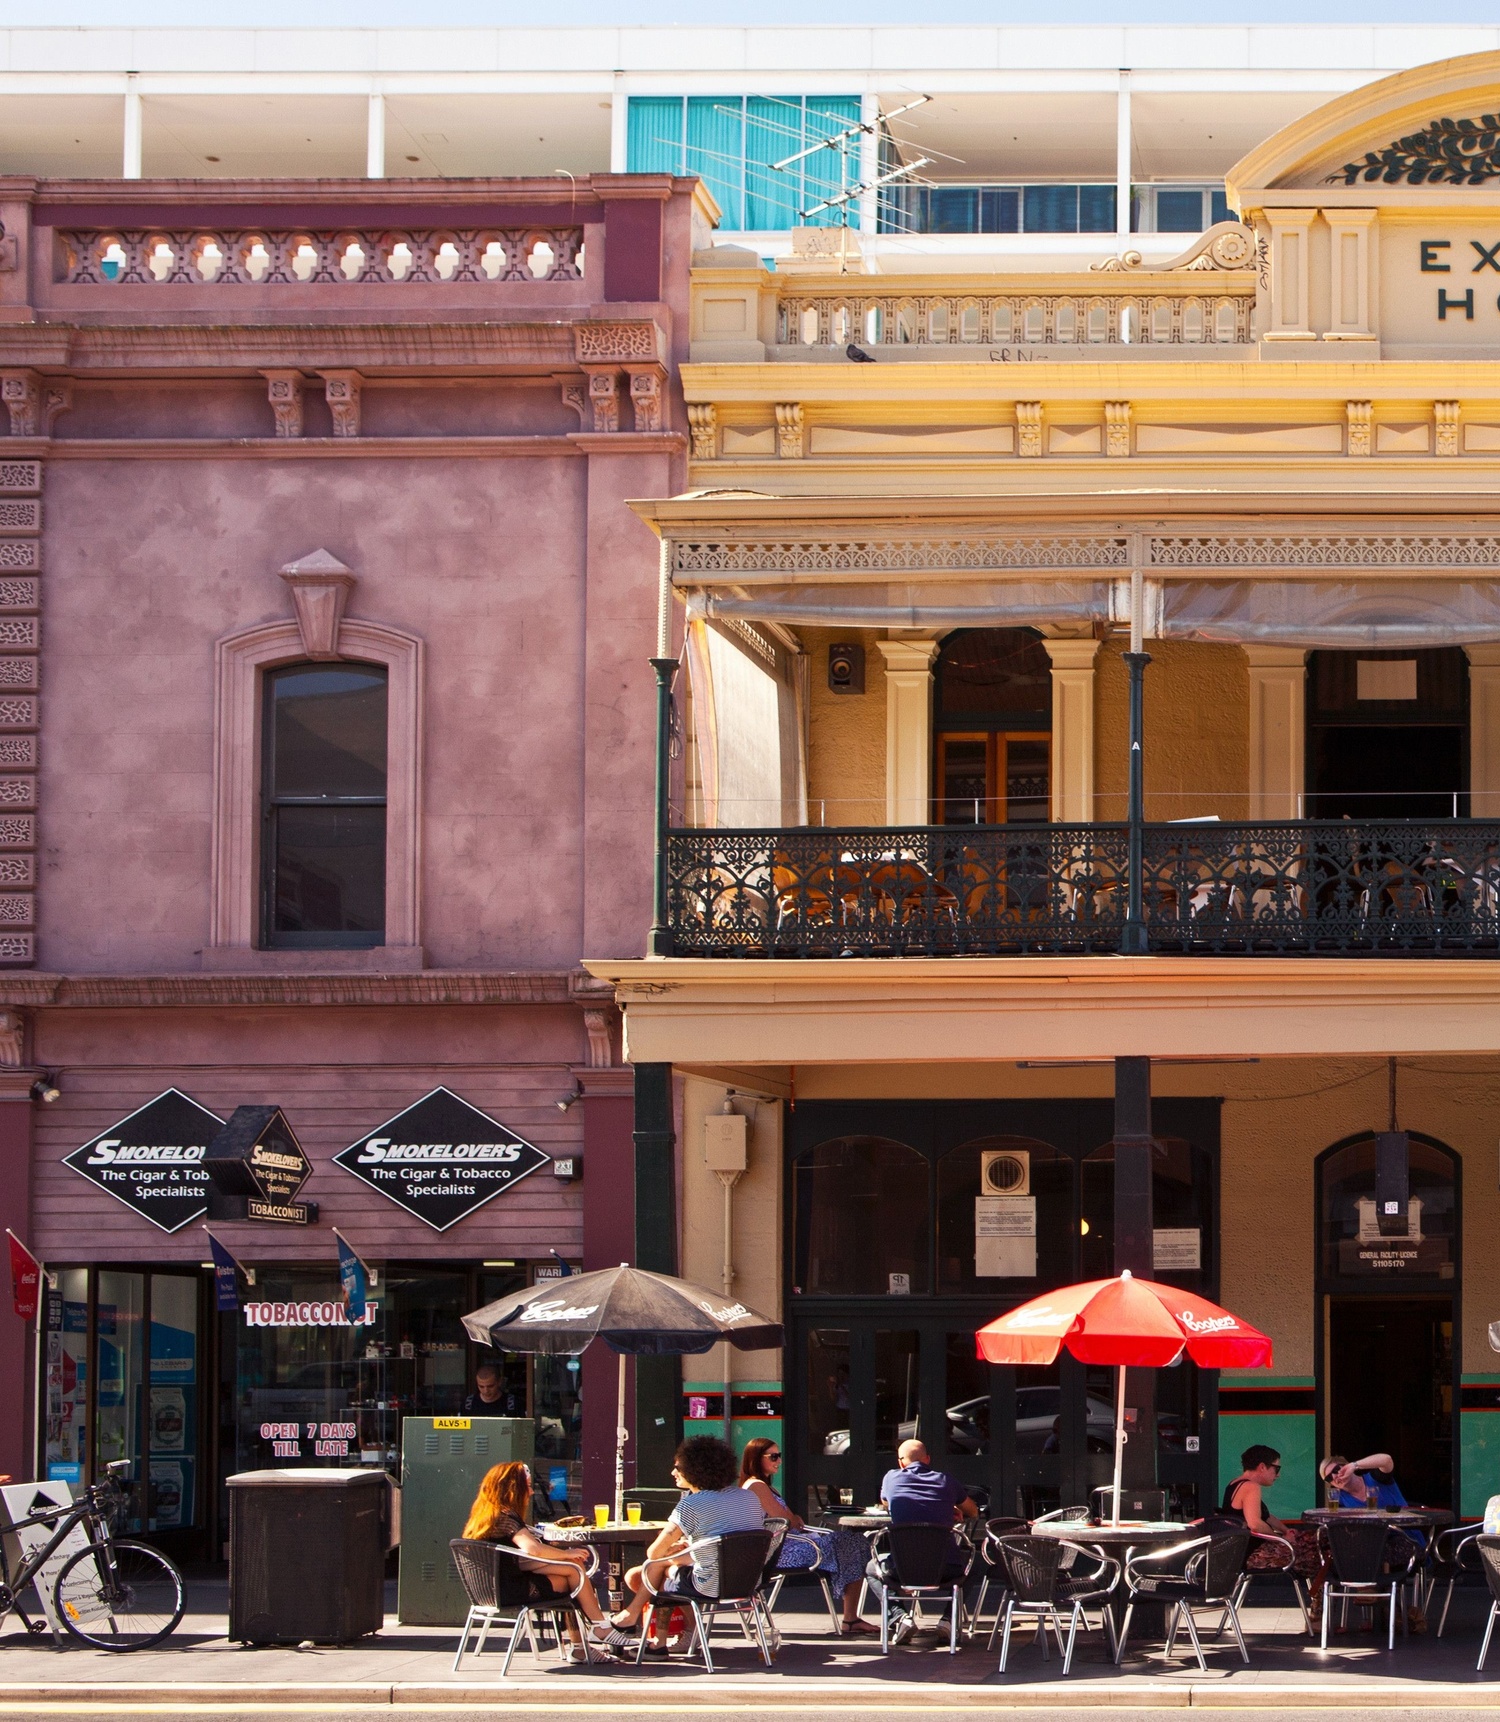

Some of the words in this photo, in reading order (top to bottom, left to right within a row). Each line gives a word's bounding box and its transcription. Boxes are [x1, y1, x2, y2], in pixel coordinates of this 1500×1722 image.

[87, 1139, 206, 1164] SMOKELO
[251, 1145, 303, 1171] SMOKELOVERS
[357, 1138, 523, 1163] SMOKELOVERS
[101, 1169, 126, 1181] The
[130, 1169, 165, 1183] Cigar
[169, 1169, 180, 1181] &
[255, 1169, 265, 1178] The
[371, 1168, 397, 1180] The
[400, 1168, 437, 1181] Cigar
[439, 1168, 450, 1179] &
[453, 1168, 511, 1179] Tobacco
[136, 1186, 205, 1199] Specialists
[406, 1184, 475, 1198] Specialists
[251, 1204, 303, 1219] TOBACCONIST
[1175, 1311, 1240, 1334] Coopers
[260, 1423, 299, 1439] OPEN
[307, 1423, 317, 1438] 7
[320, 1423, 356, 1439] DAYS
[273, 1441, 301, 1457] TILL
[315, 1440, 348, 1456] LATE
